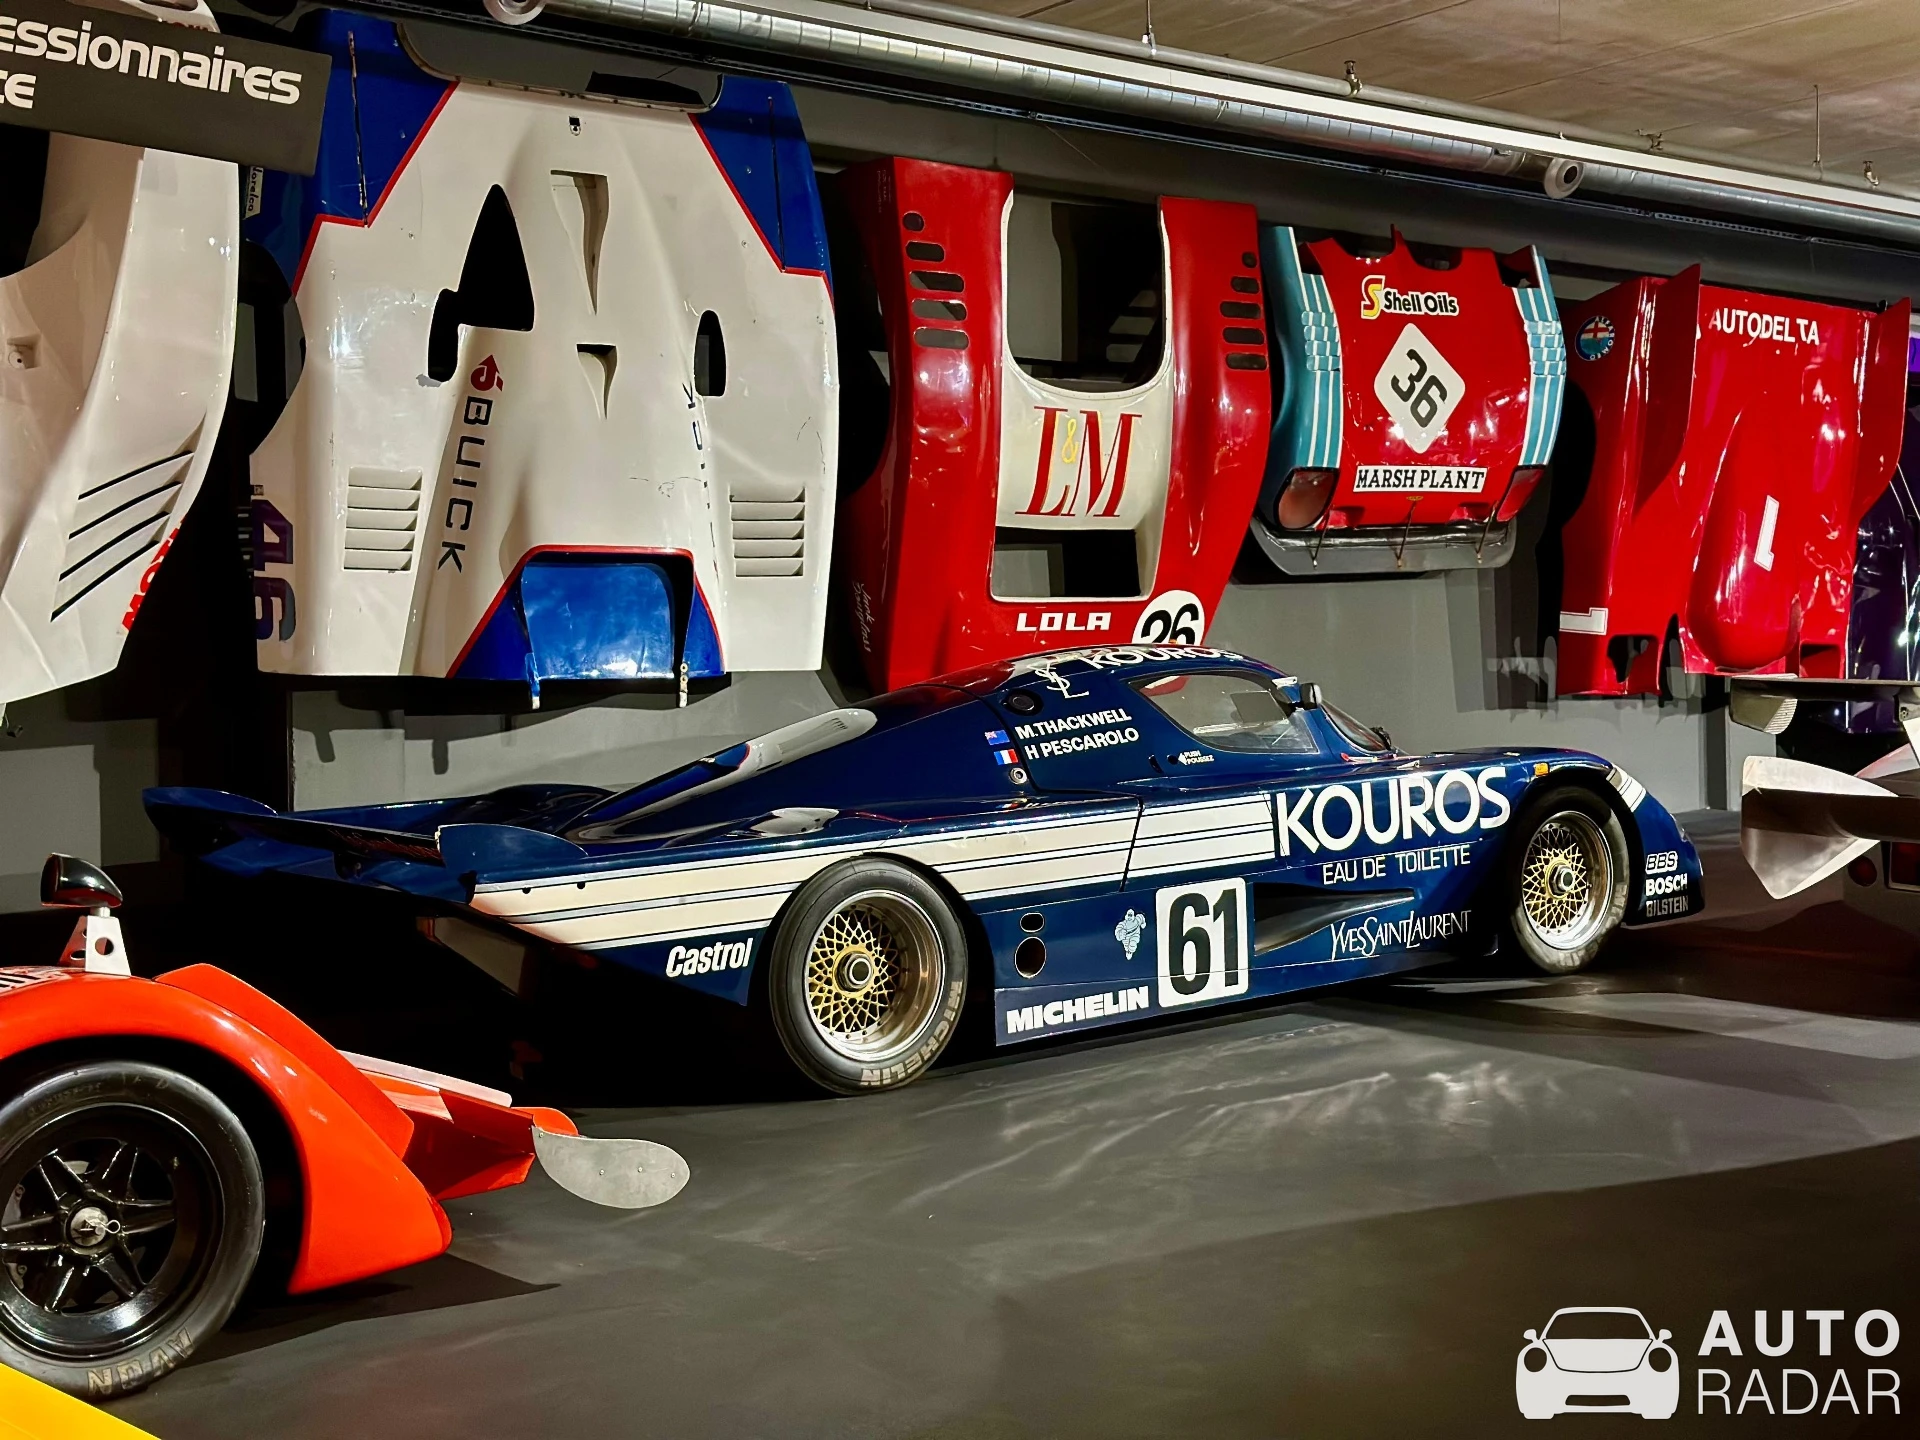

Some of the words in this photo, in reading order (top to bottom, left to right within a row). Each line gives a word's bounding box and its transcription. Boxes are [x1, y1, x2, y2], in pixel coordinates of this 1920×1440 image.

[1383, 290, 1422, 313] Shell
[1424, 294, 1458, 314] Oils
[1708, 307, 1820, 346] AUTODELTA
[1390, 348, 1448, 429] 36
[437, 395, 494, 574] BUICK
[1356, 468, 1419, 489] MARSH
[1420, 469, 1485, 490] PLANT
[1016, 611, 1112, 632] LOLA
[1140, 602, 1199, 644] 26
[1080, 646, 1243, 670] KOUROS
[1025, 744, 1040, 760] H
[1041, 727, 1140, 758] PESCAROLO
[1276, 766, 1511, 857] KOUROS
[1322, 860, 1358, 885] EAU
[1362, 855, 1387, 880] DE
[1394, 844, 1471, 874] TOILETTE
[1645, 850, 1678, 875] BBS
[1645, 872, 1688, 897] BOSCH
[1645, 895, 1689, 918] BILSTEIN
[665, 937, 754, 979] Castrol
[1168, 887, 1239, 996] 61
[1006, 985, 1150, 1035] MICHELIN
[860, 981, 963, 1087] MICHELIN
[87, 1327, 195, 1396] AVON
